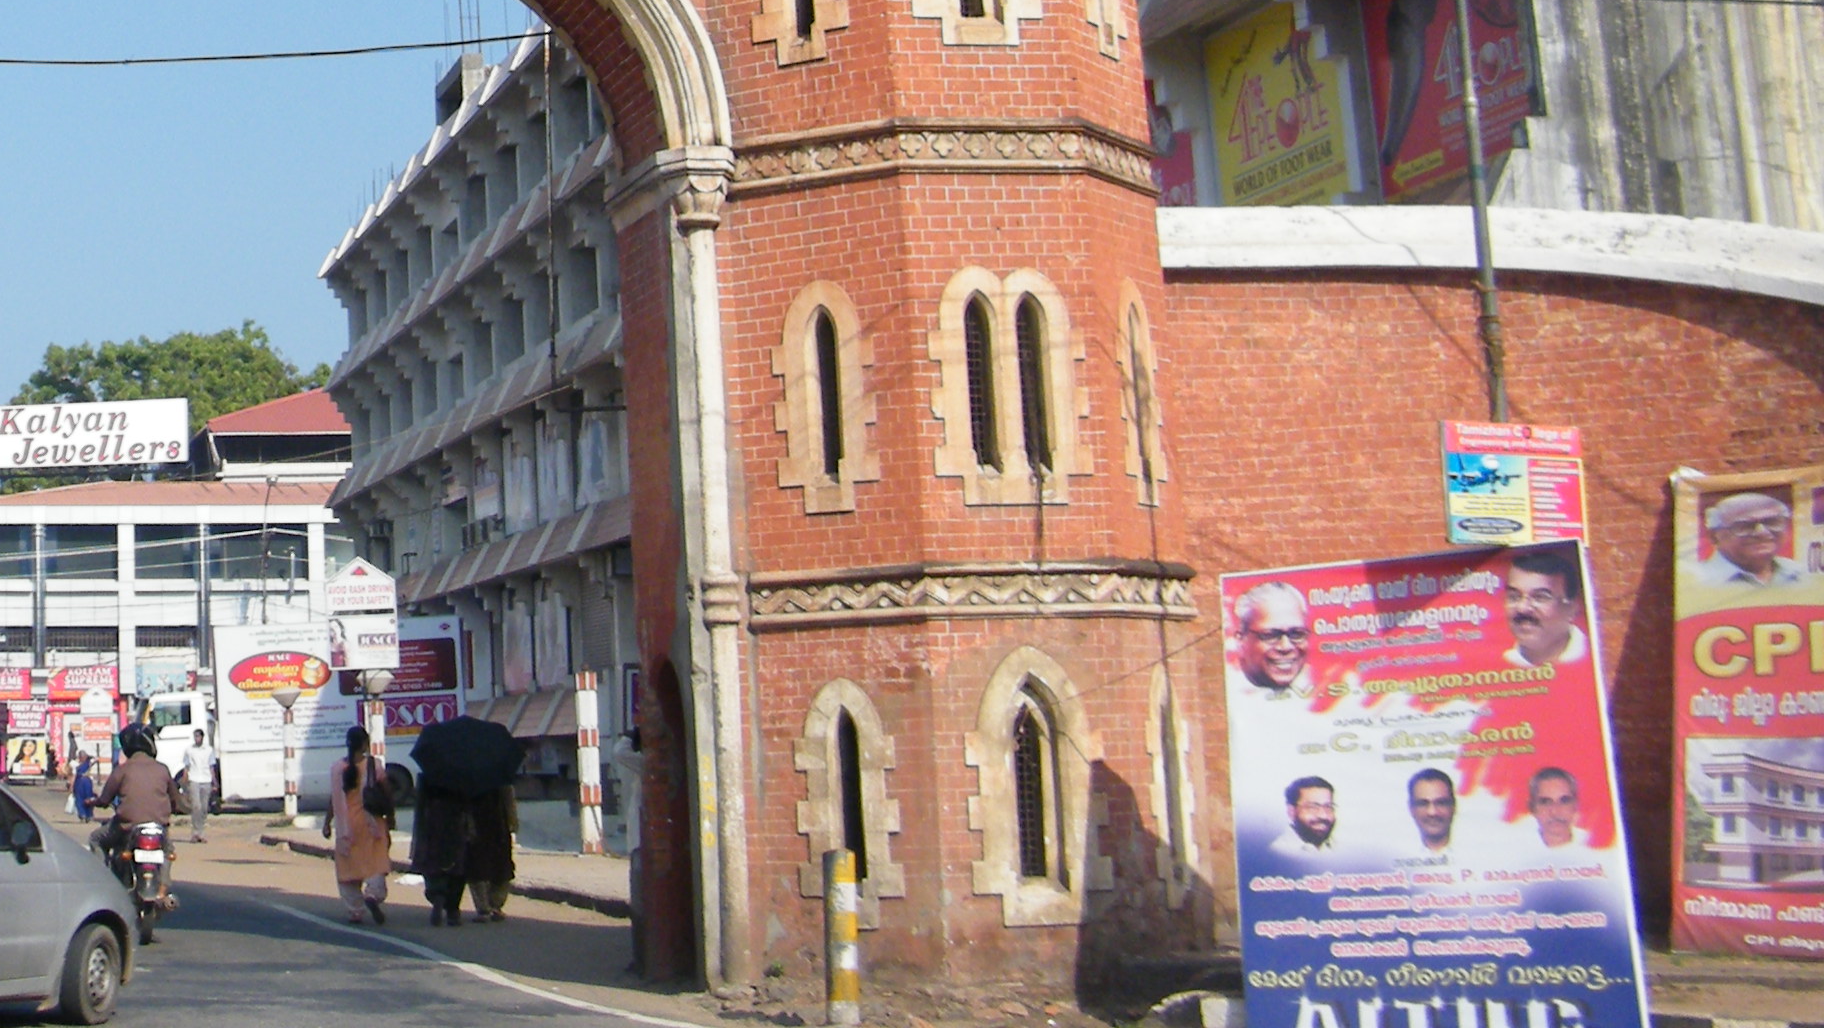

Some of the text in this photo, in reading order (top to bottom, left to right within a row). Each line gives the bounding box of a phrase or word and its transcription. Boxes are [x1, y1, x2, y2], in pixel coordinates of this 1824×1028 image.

[1232, 169, 1265, 197] WORLD
[1266, 162, 1279, 184] OF
[1279, 151, 1305, 179] FOOT
[1305, 138, 1334, 166] WEAR
[12, 434, 182, 466] Jewellers
[328, 585, 347, 595] AVOID
[349, 584, 366, 594] RASH
[332, 595, 391, 606] FOR YOUR SAFETY
[64, 675, 114, 685] SUPREME
[32, 704, 46, 712] ALL
[12, 712, 42, 720] TRAFFIC
[16, 720, 41, 728] RULES
